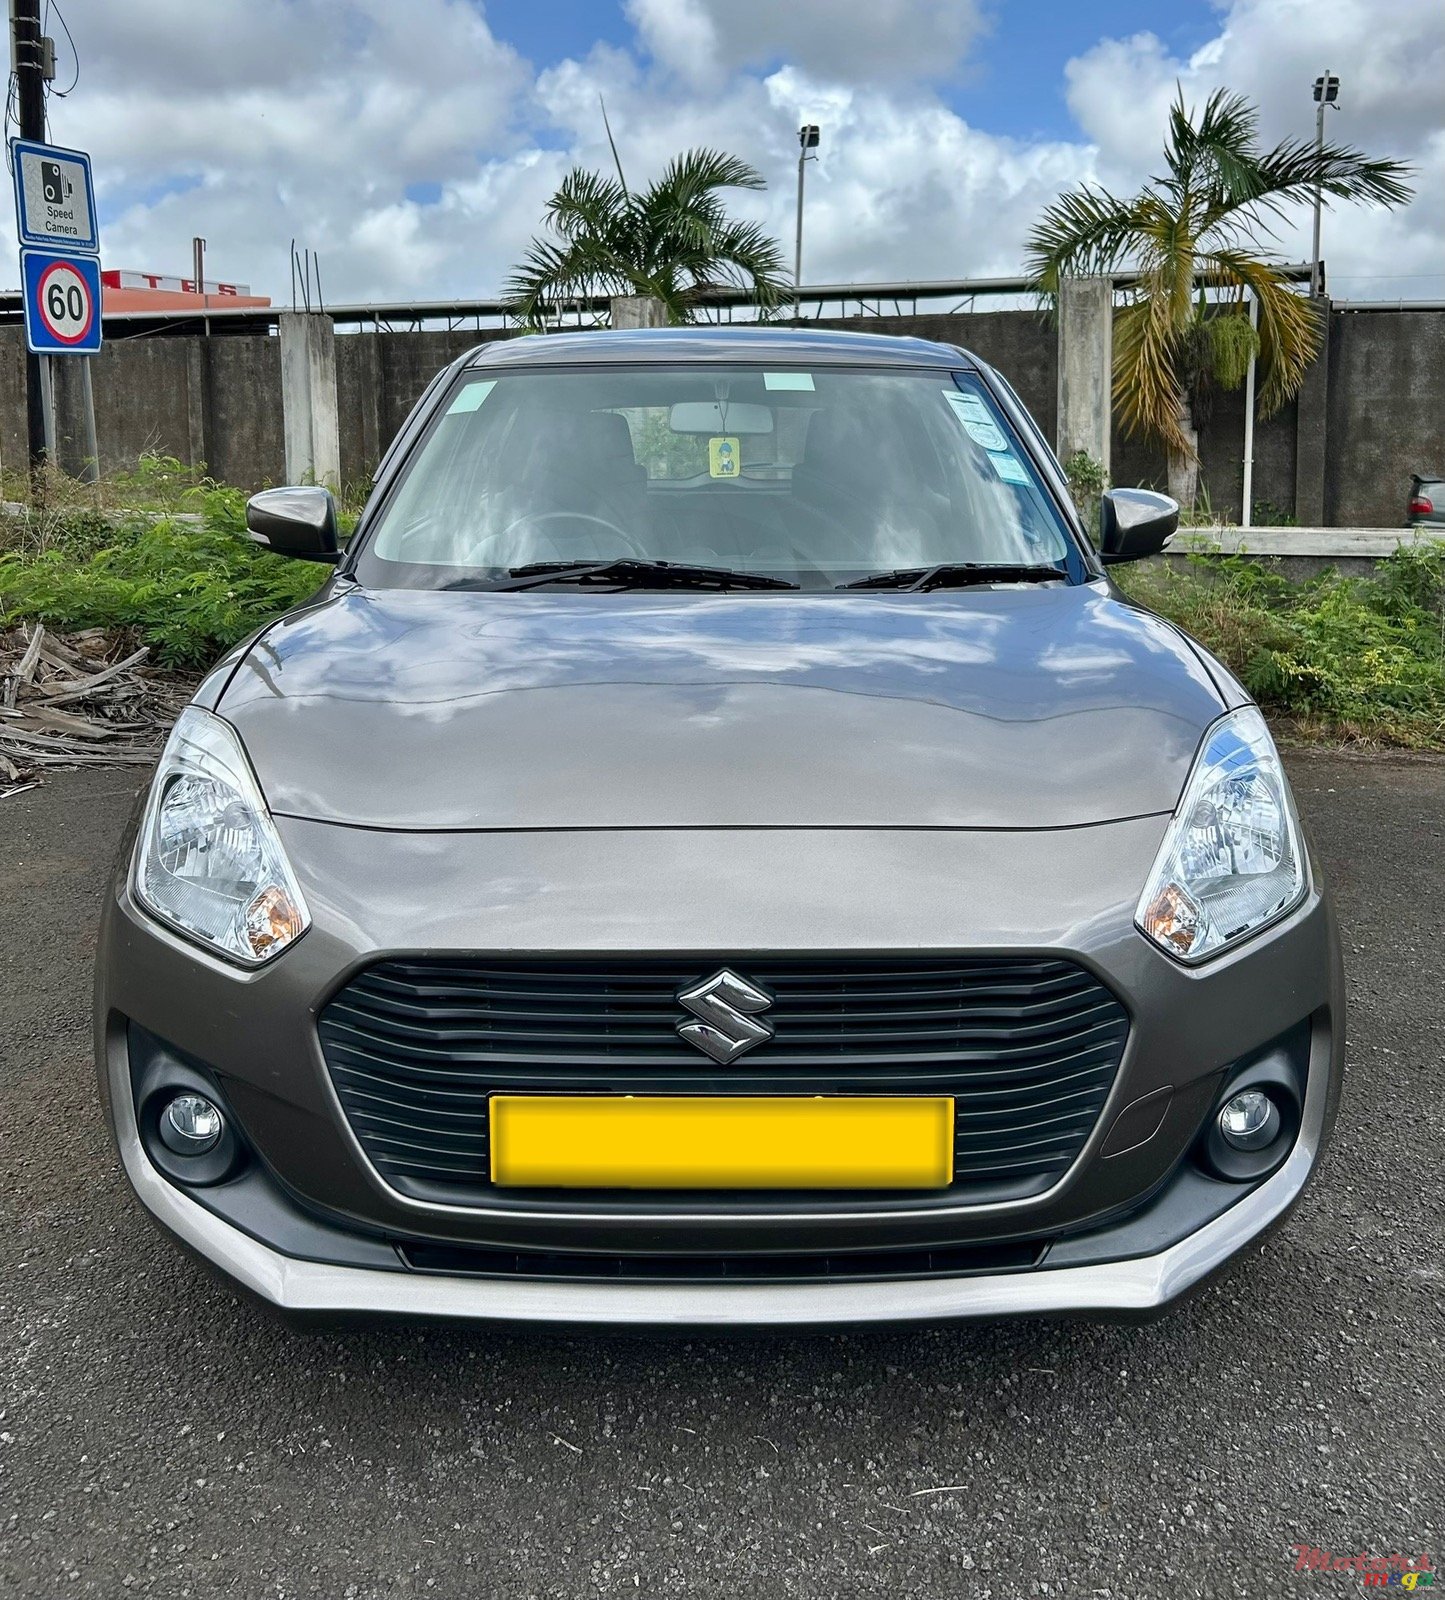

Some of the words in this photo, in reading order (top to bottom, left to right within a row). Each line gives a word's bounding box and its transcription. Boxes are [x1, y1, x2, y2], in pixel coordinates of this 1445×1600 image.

[47, 206, 73, 219] Speed
[45, 221, 78, 235] Camera
[48, 284, 83, 321] 60
